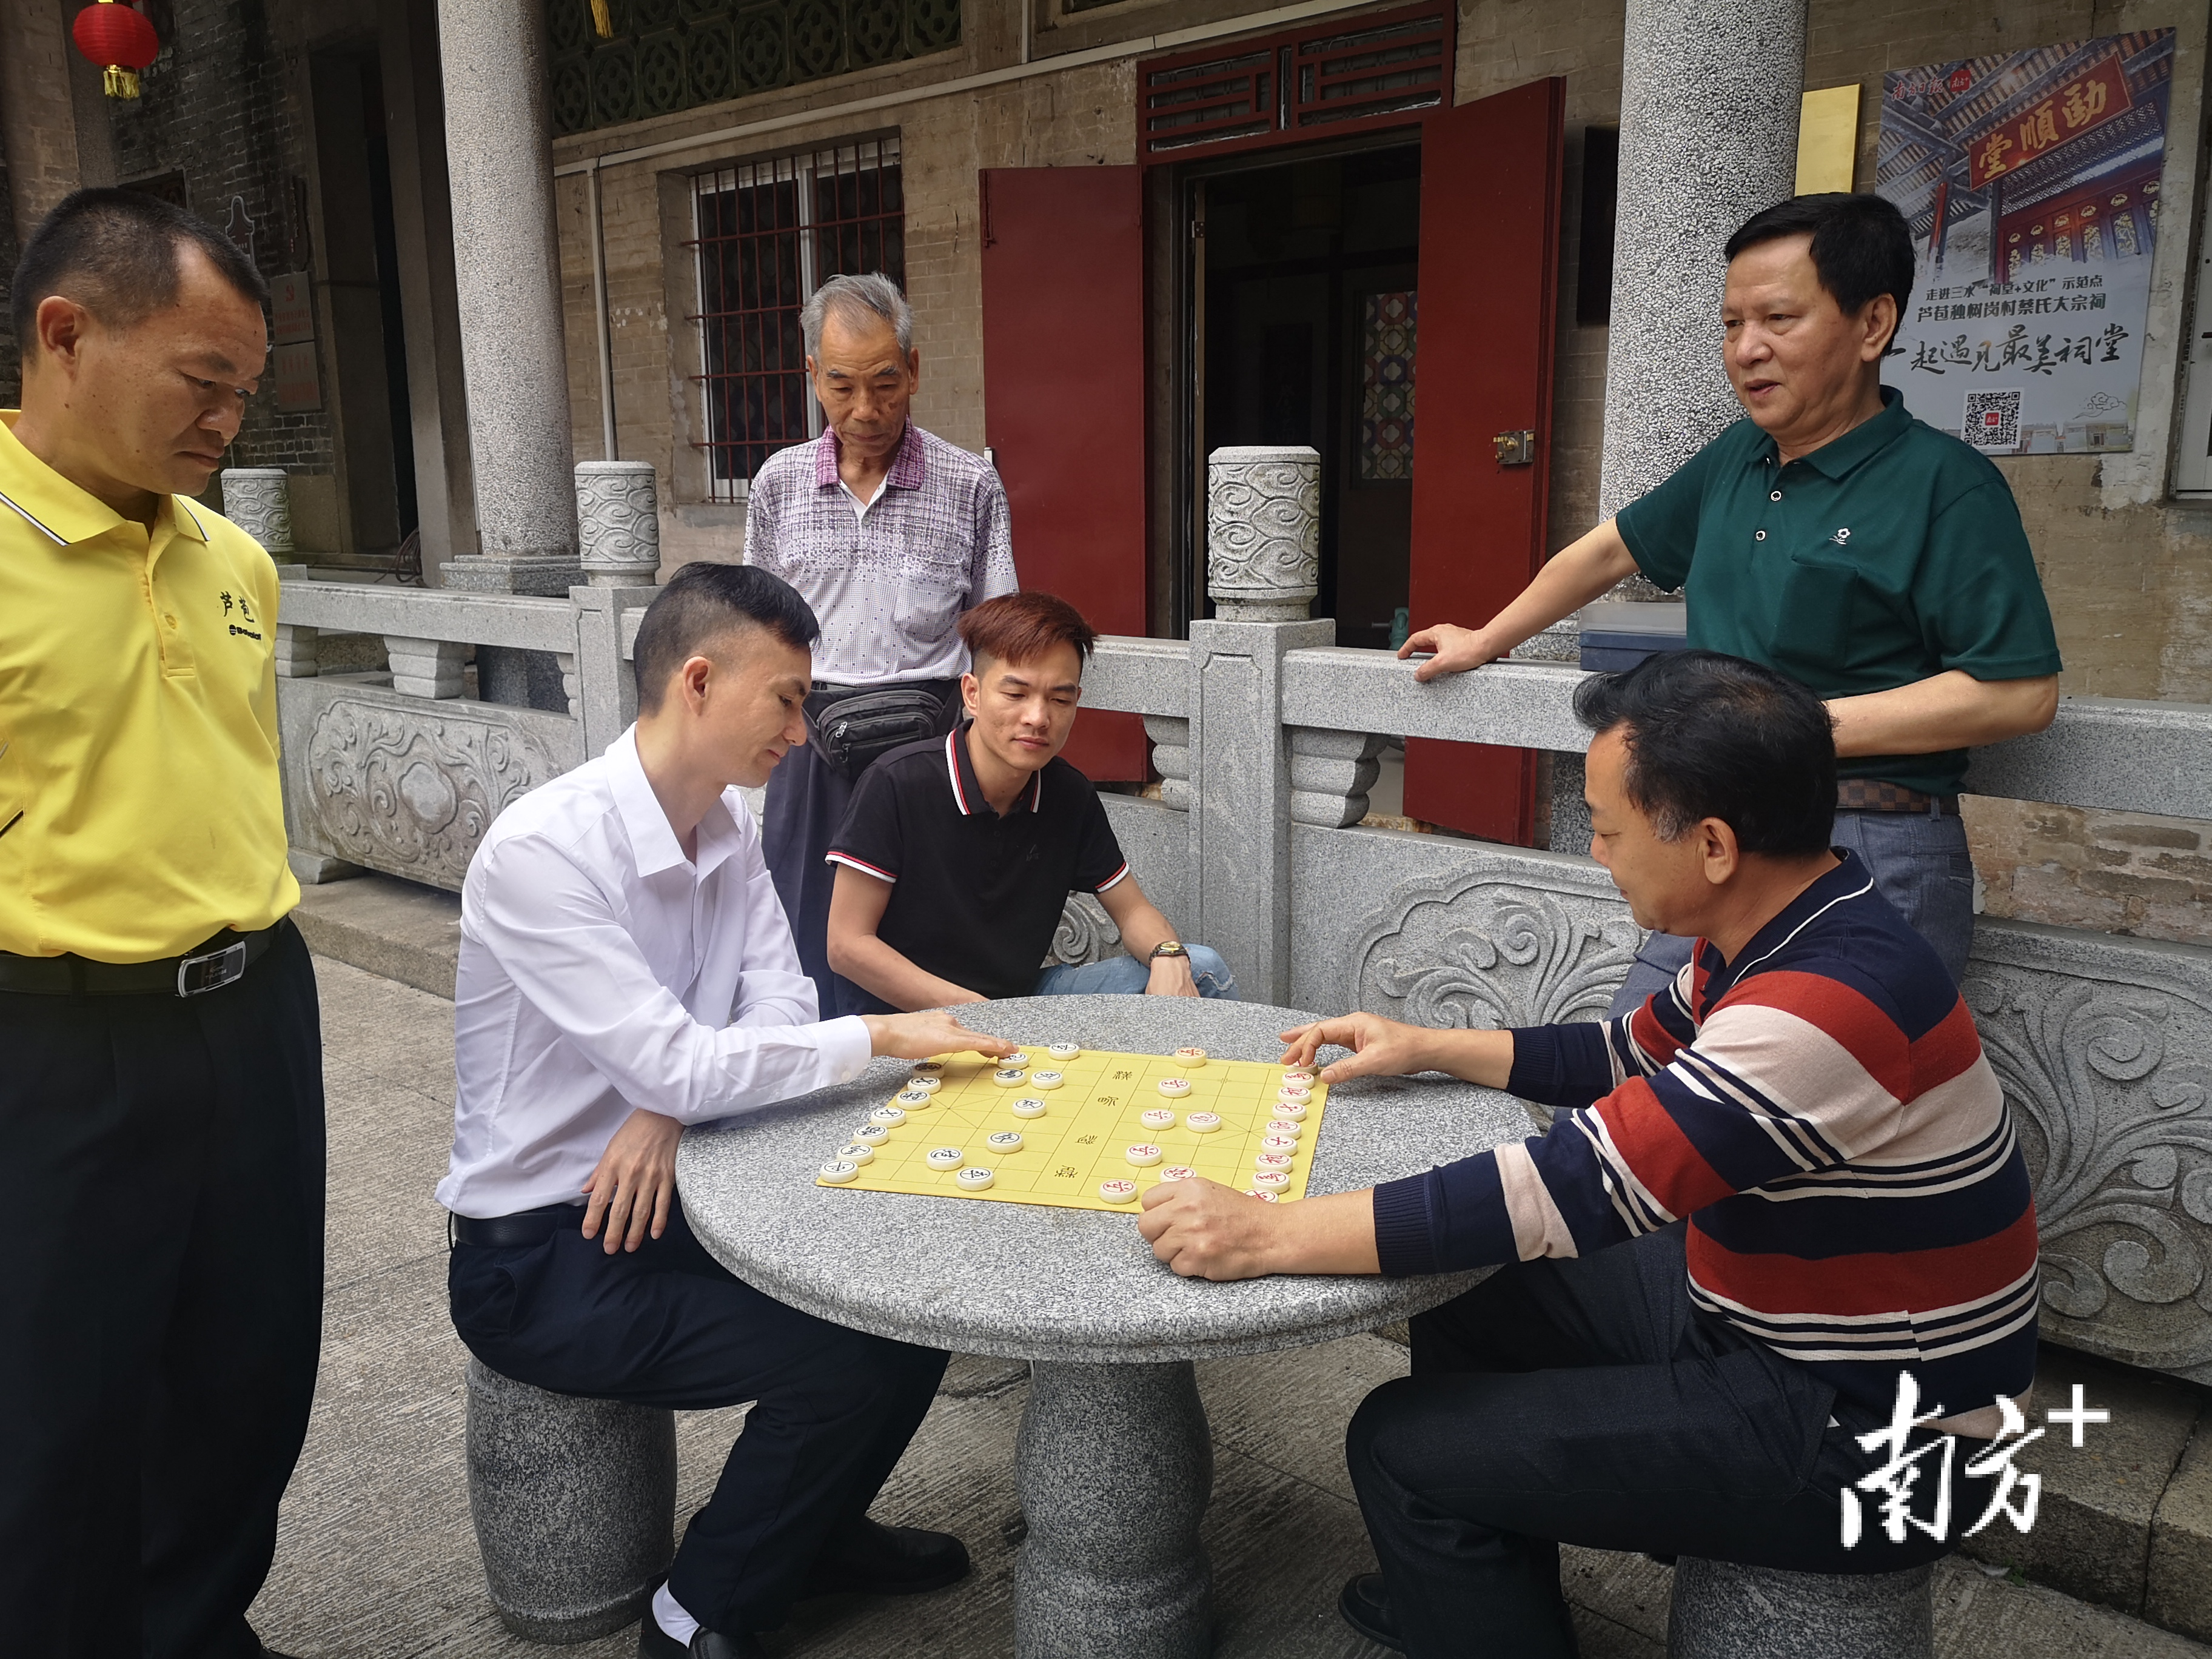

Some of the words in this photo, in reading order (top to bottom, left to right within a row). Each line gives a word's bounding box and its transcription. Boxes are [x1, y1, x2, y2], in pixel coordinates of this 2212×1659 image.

[1891, 76, 1943, 101] 南方日报
[1917, 293, 2106, 323] 芦苞独树岗村蔡氏大宗祠
[220, 591, 255, 623] 芦苞
